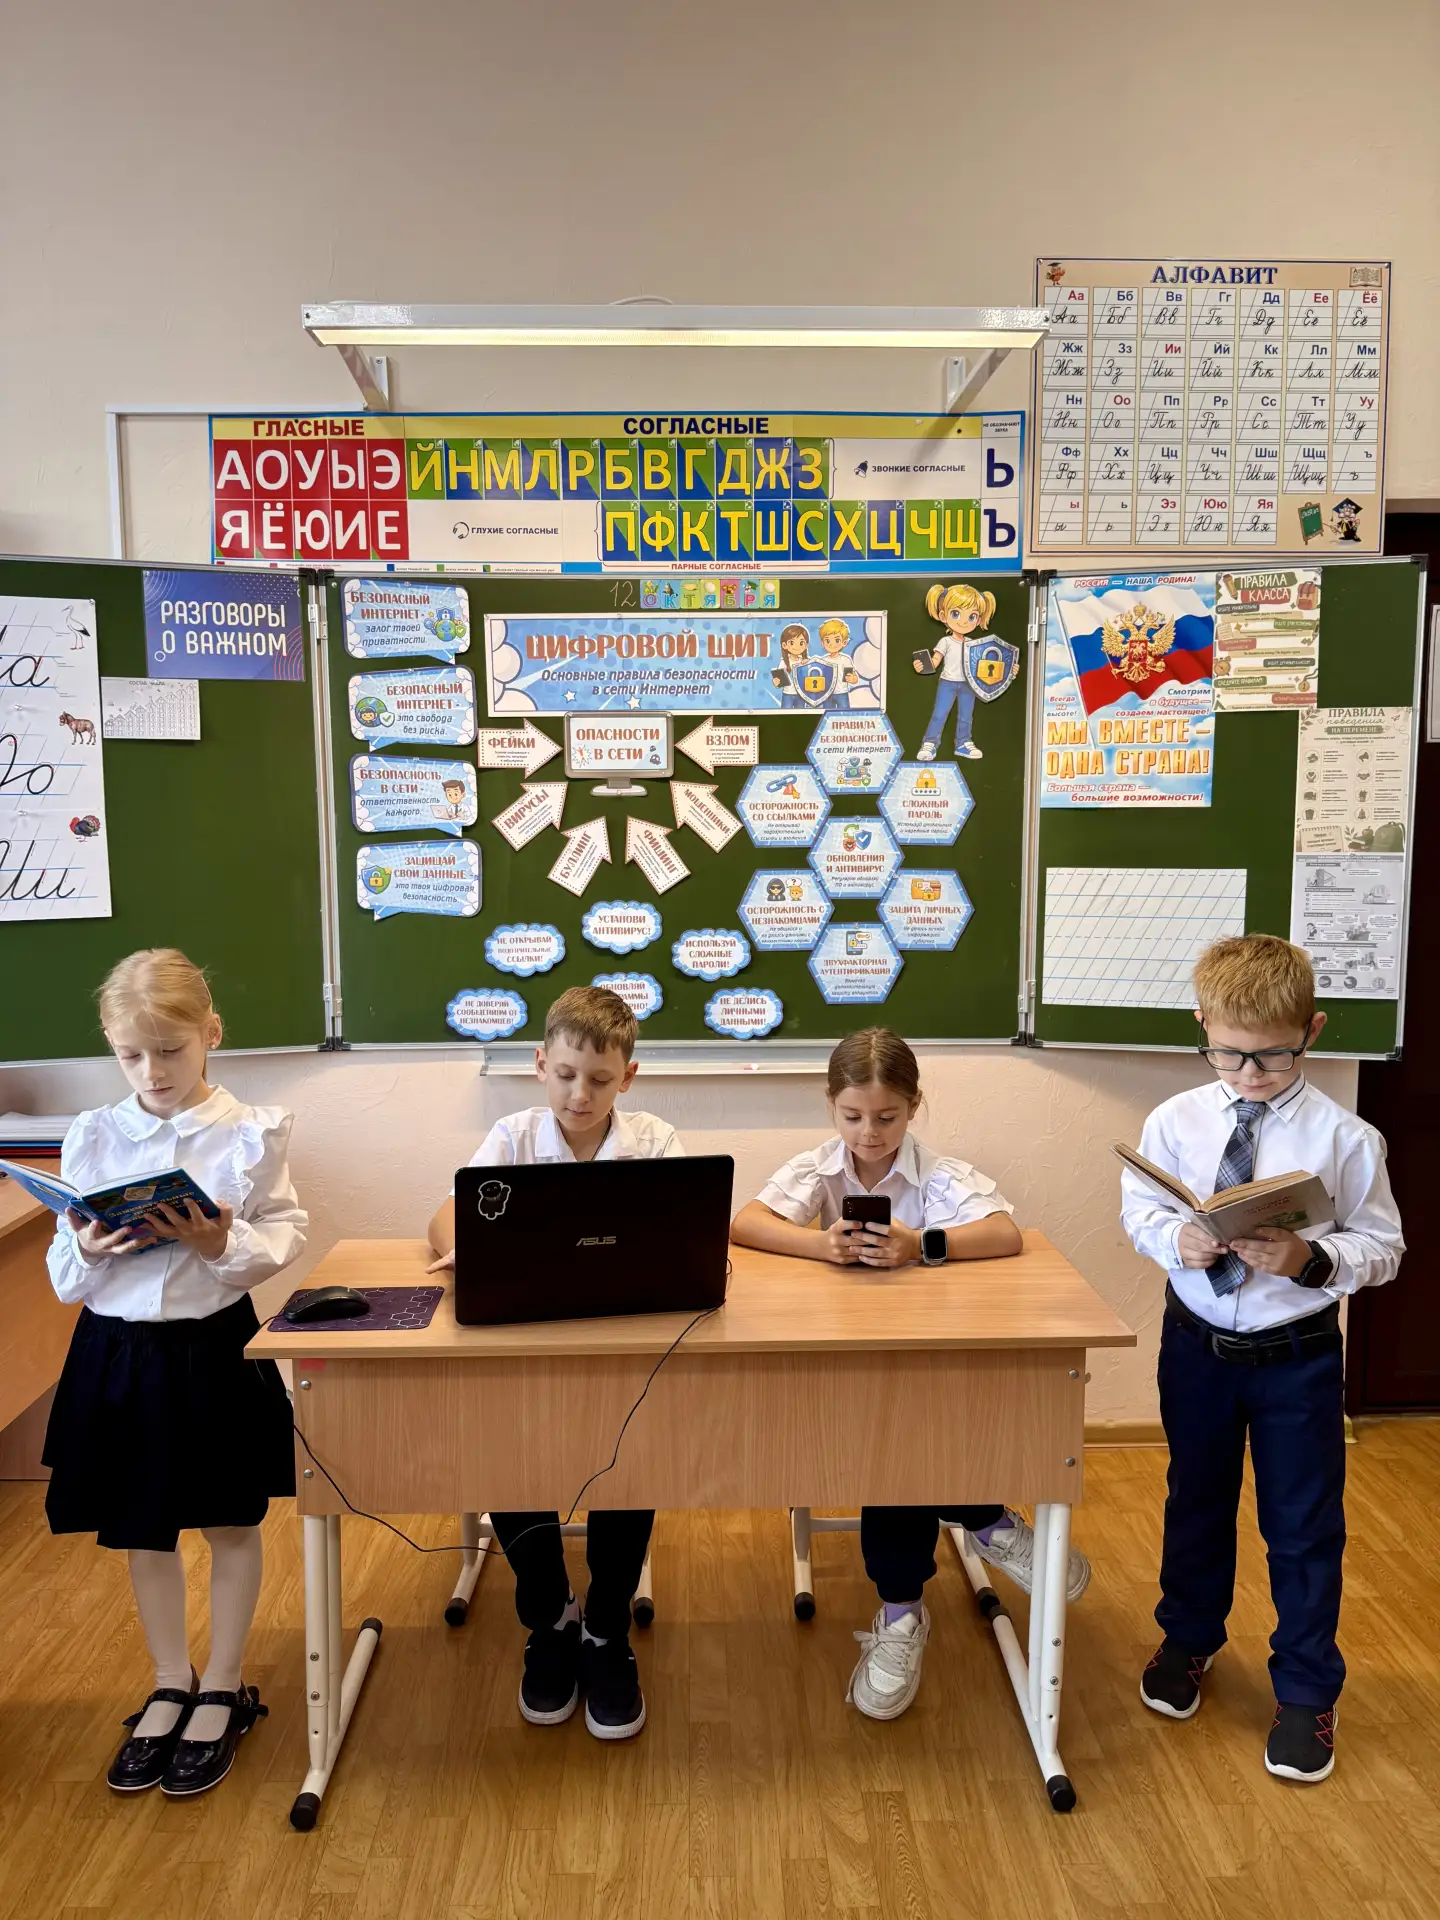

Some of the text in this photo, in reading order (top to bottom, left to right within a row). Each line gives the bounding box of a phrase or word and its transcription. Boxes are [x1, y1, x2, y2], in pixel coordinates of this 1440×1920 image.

[1149, 266, 1278, 285] АЛФАВИТ
[1067, 290, 1378, 305] Аа Бб Вв Гг Дд Ее Ёё
[1061, 340, 1377, 356] Жж Зз Ии Йй Кк Лл Мм
[1065, 395, 1374, 409] Нн Оо Пп Рр Сс Тт Уу
[253, 419, 365, 437] ГЛАСНЫЕ
[623, 417, 769, 435] СОГЛАСНЫЕ
[872, 464, 967, 474] ЗВОНКИЕ СОГЛАСНЫЕ
[986, 448, 1015, 489] Ь
[471, 526, 559, 536] ГЛУХИЕ СОГЛАСНЫЕ
[983, 508, 1016, 549] Ъ
[671, 562, 762, 571] ПАРНЫЕ СОГЛАСНЫЕ
[1074, 576, 1197, 588] РОССИЯ НАША РОДИНА!
[1240, 573, 1288, 589] ПРАВИЛА
[350, 591, 430, 605] БЕЗОПАСНЫЙ
[609, 580, 637, 607] 12
[1248, 588, 1290, 602] КЛАССА
[161, 602, 286, 628] РАЗГОВОРЫ
[365, 623, 421, 633] залог твоей
[162, 631, 287, 657] О ВАЖНОМ
[525, 630, 773, 661] ЦИФРОВОЙ ЩИТ
[541, 668, 756, 683] Основные правила безопасности
[386, 681, 463, 696] БЕЗОПАСНЫЙ
[592, 682, 711, 697] в сети Интернет
[1167, 688, 1211, 696] Смотрим
[396, 699, 453, 710] ИНТЕРНЕТ
[1055, 703, 1067, 711] на
[1158, 698, 1199, 708] будущее
[416, 713, 453, 723] свобода
[1156, 708, 1210, 718] настоящее!
[1328, 708, 1386, 718] ПРАВИЛА
[403, 725, 417, 734] без
[831, 721, 876, 730] ПРАВИЛА
[576, 728, 660, 741] ОПАСНОСТИ
[1047, 718, 1190, 746] МЫ ВМЕСТЕ
[487, 735, 536, 749] ФЕЙКИ
[706, 734, 750, 746] ВЗЛОМ
[820, 734, 888, 744] БЕЗОПАСНОСТИ
[594, 747, 643, 760] В СЕТИ
[846, 745, 892, 754] Интернет
[1046, 749, 1210, 779] ОДНА СТРАНА!
[360, 769, 442, 780] БЕЗОПАСНОСТЬ
[380, 784, 418, 794] В СЕТИ
[1047, 783, 1137, 793] Большая страна
[360, 798, 441, 807] ответственность
[1071, 793, 1204, 802] большие возможности!
[749, 802, 820, 811] ОСТОРОЖНОСТЬ
[902, 799, 949, 808] СЛОЖНЫЙ
[503, 789, 550, 830] ВИРУСЫ
[683, 788, 731, 835] МОШЕННИКИ
[752, 813, 816, 821] СО ССЫЛКАМИ
[907, 811, 943, 819] ПАРОЛЬ
[559, 830, 592, 880] БУЛЛИНГ
[643, 829, 679, 874] ФИШИНГ
[404, 855, 456, 866] ЗАЩИЩАЙ
[826, 854, 885, 862] ОБНОВЛЕНИЯ
[826, 865, 885, 873] И АНТИВИРУС
[393, 869, 467, 880] СВОИ ДАННЫЕ
[432, 884, 475, 893] цифровая
[747, 906, 817, 915] ОСТОРОЖНОСТЬ
[888, 906, 962, 914] ЗАЩИТА ЛИЧНЫХ
[598, 915, 646, 924] УСТАНОВИ
[751, 917, 820, 925] НЕЗНАКОМЦАМИ
[905, 916, 943, 925] ДАННЫХ
[592, 926, 651, 935] АНТИВИРУС!
[509, 936, 552, 945] ОТКРЫВАЙ
[685, 939, 737, 948] ИСПОЛЬЗУЙ
[689, 950, 733, 958] СЛОЖНЫЕ
[575, 1236, 617, 1247] ASUS
